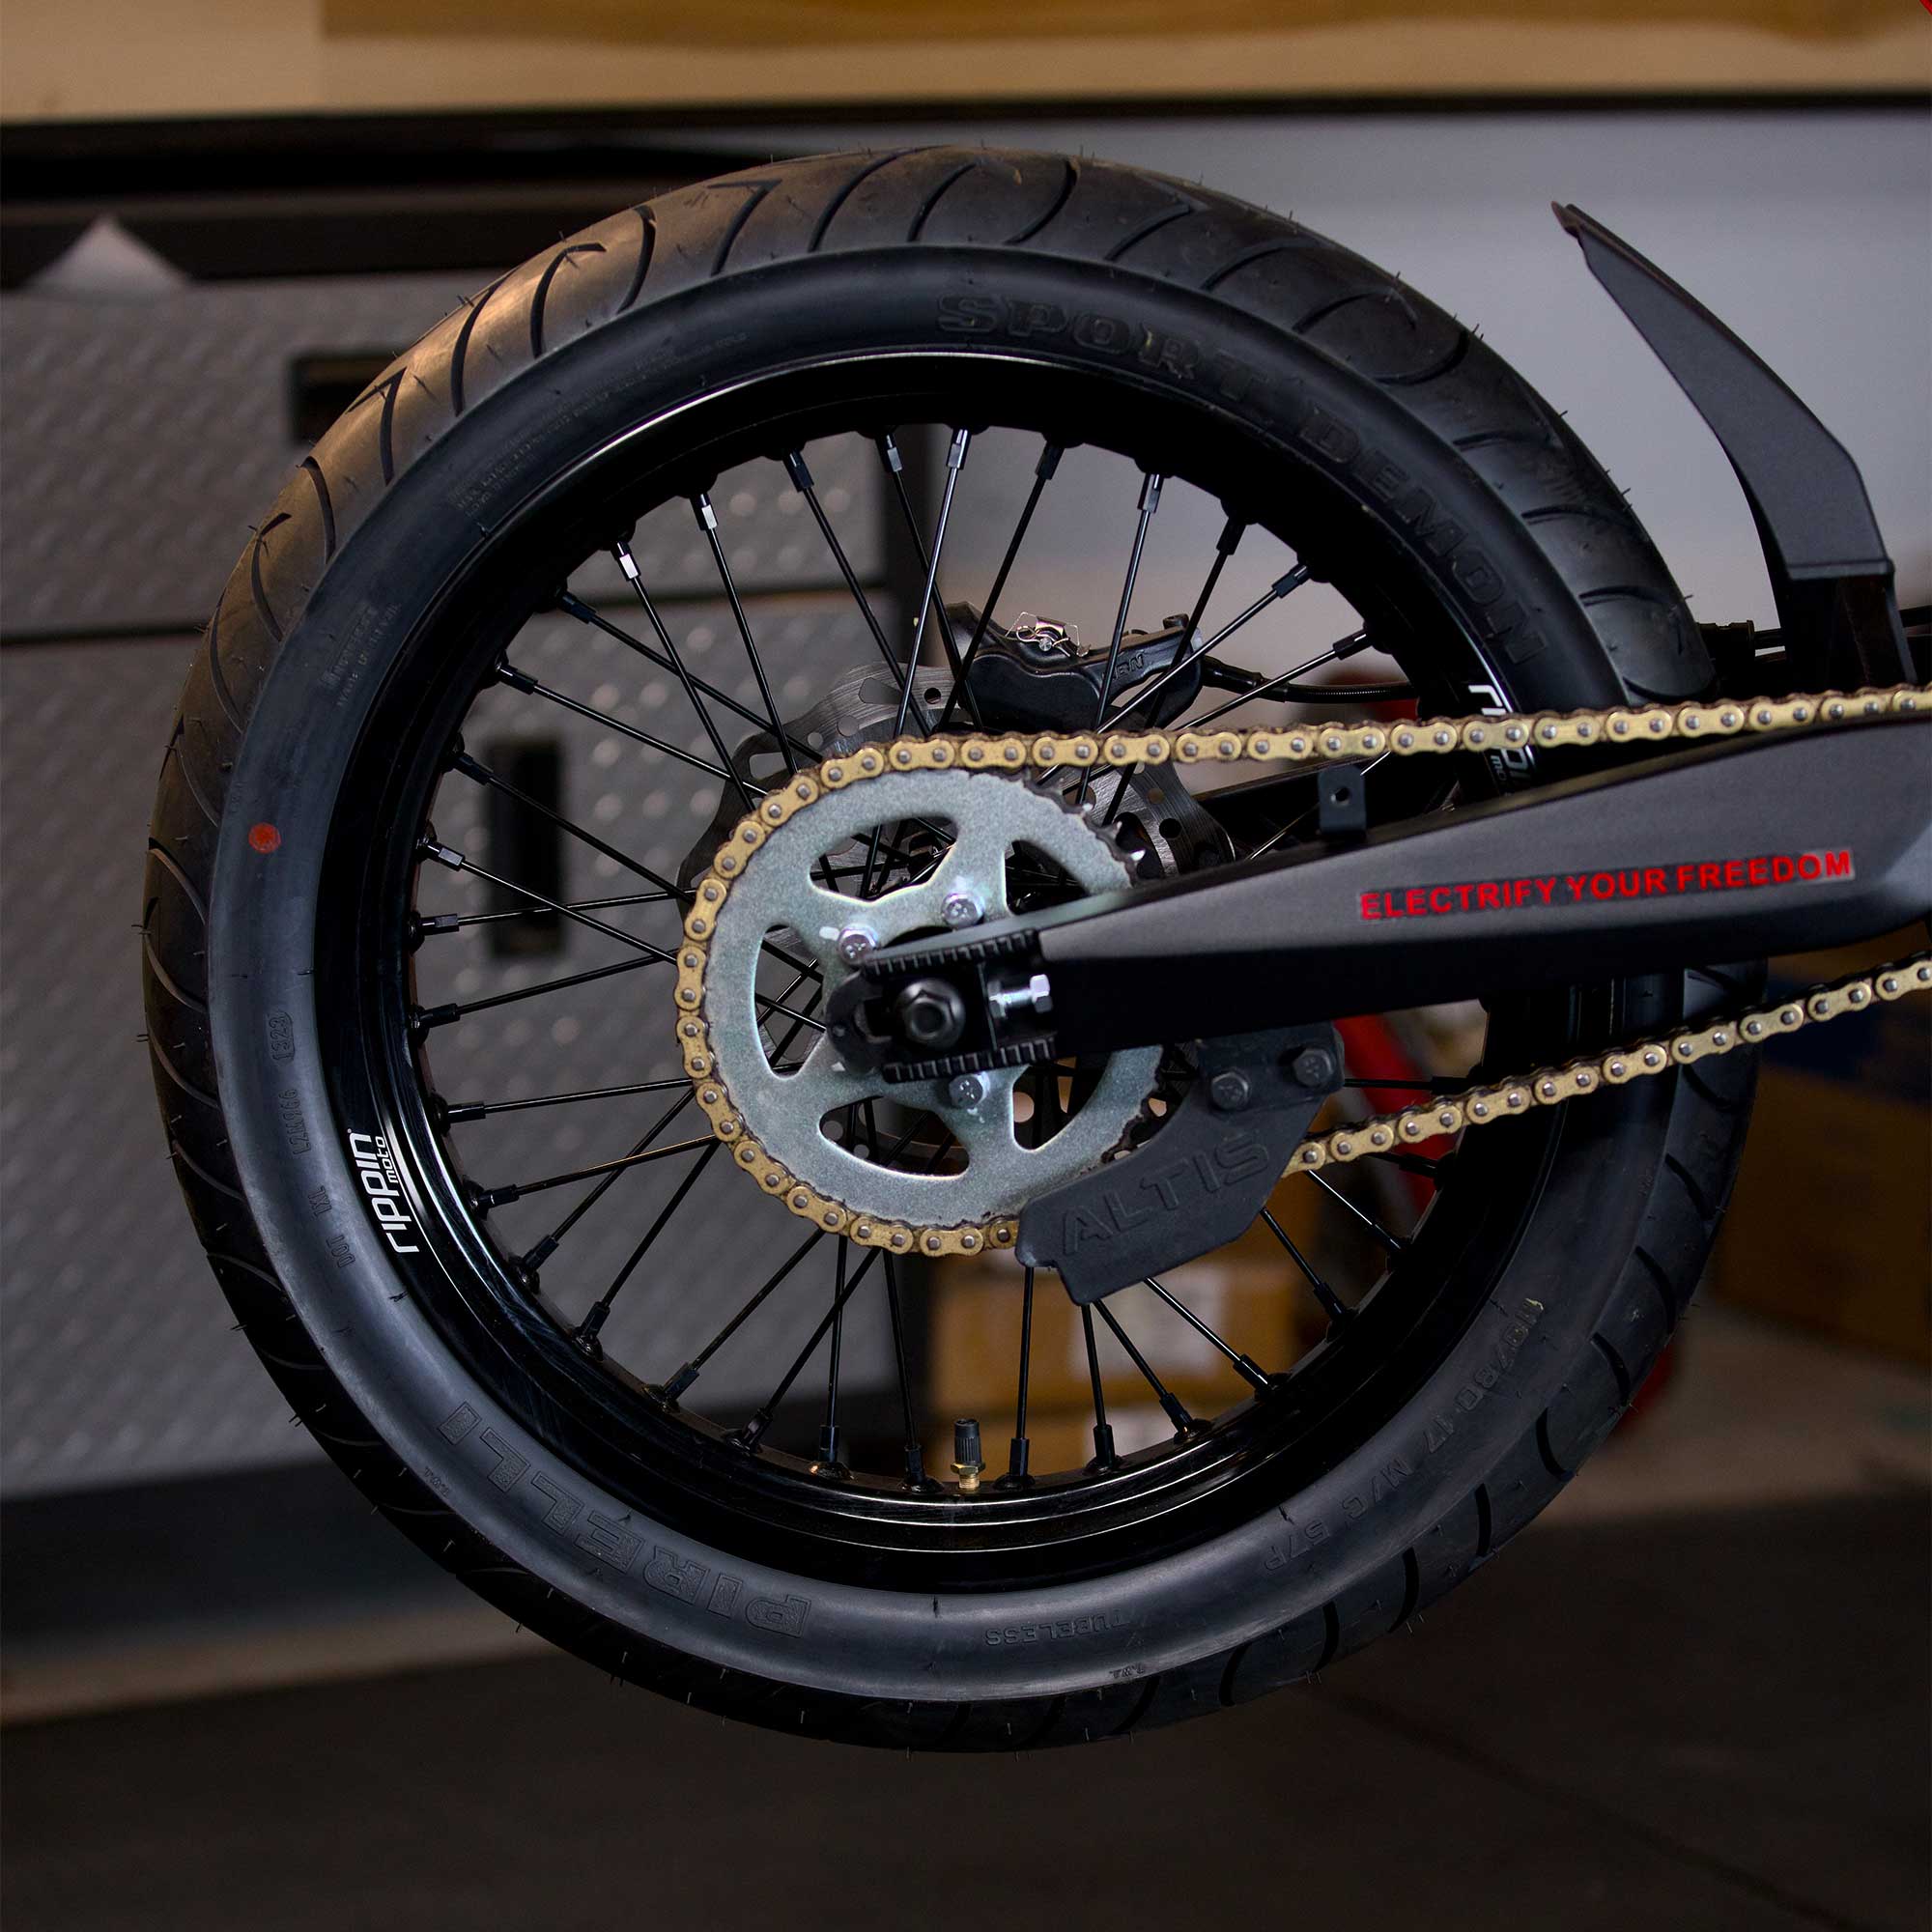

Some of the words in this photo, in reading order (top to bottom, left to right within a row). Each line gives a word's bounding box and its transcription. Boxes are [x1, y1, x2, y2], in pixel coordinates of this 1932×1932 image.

[935, 295, 1260, 401] SPORT
[1296, 399, 1546, 667] DEMON
[1360, 877, 1556, 920] ELECTRIFY
[1566, 867, 1668, 901] YOUR
[1676, 851, 1851, 892] FREEDOM
[349, 1132, 420, 1254] rippin
[375, 1136, 399, 1183] moto
[1064, 1129, 1269, 1256] ALTIS
[326, 1235, 355, 1268] DOT
[437, 1401, 812, 1639] PIRELLI
[985, 1609, 1130, 1646] TUBELESS
